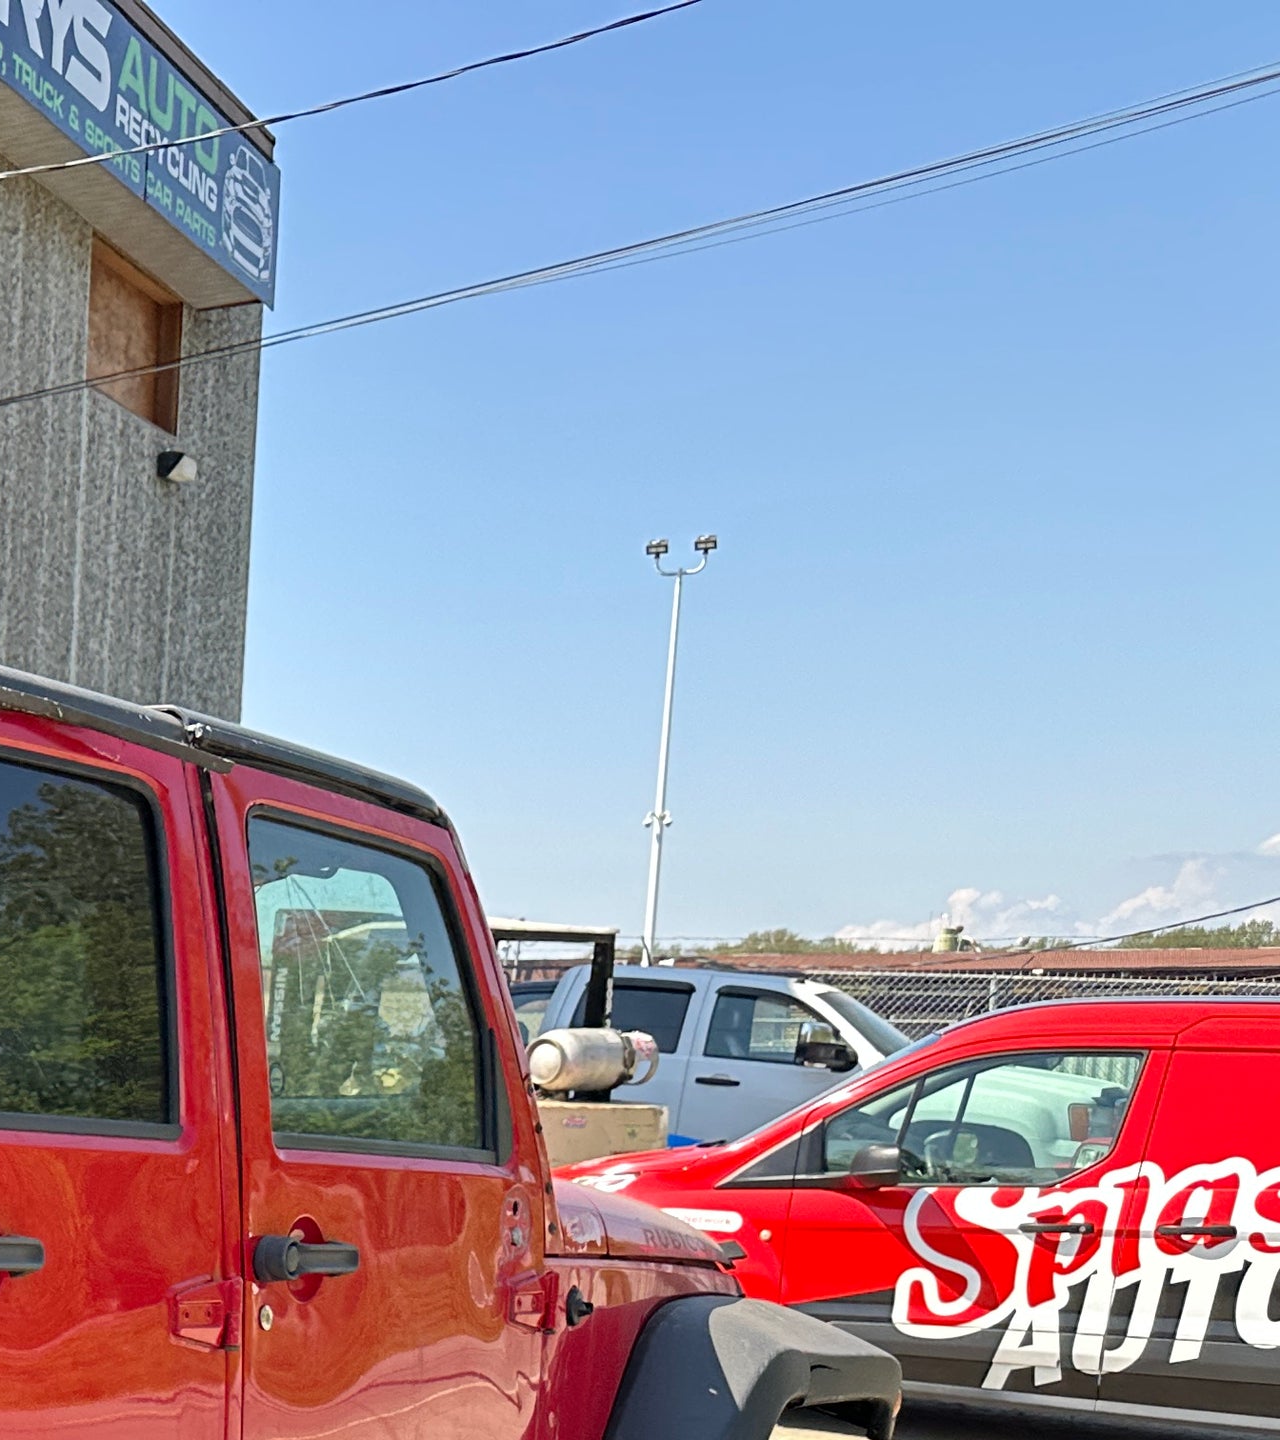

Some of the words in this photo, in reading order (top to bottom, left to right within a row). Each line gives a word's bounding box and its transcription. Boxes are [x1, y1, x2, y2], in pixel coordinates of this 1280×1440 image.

[12, 53, 65, 119] TRUCK
[68, 104, 80, 132] &
[85, 118, 141, 184] SPORTS
[146, 171, 173, 212] CAR
[175, 196, 217, 247] PARTS
[114, 94, 218, 213] RECYCLING
[118, 36, 221, 175] AUTO
